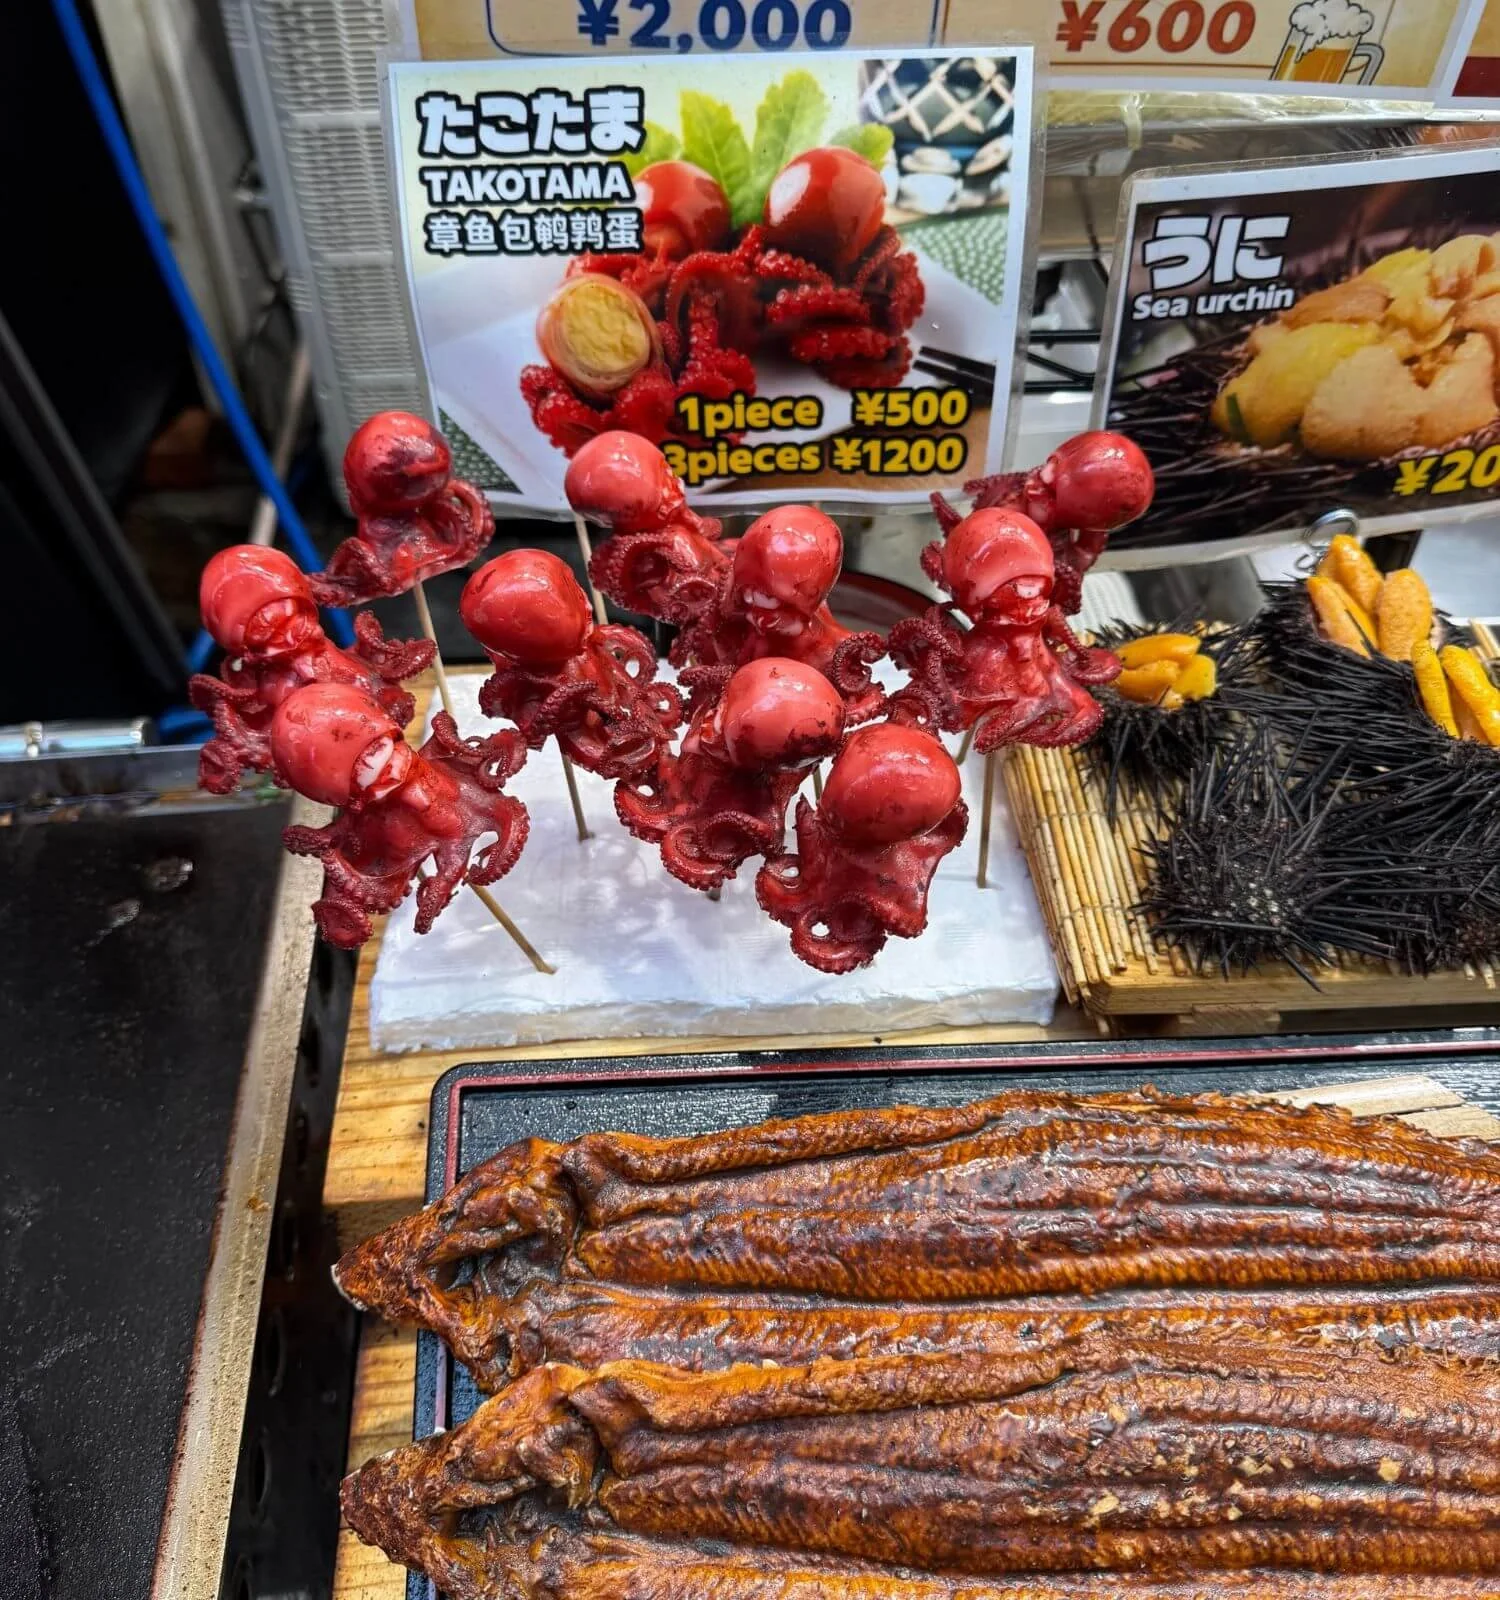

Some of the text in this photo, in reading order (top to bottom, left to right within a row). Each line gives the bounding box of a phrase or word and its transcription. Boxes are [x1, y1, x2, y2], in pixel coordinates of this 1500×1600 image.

[577, 0, 852, 53] ¥2,000
[1055, 0, 1256, 53] ¥600
[419, 88, 644, 155] たこたま
[422, 166, 632, 202] TAKOTAMA
[425, 212, 640, 252] 章鱼包鹌鹑蛋
[1143, 215, 1291, 290] うに
[1132, 284, 1294, 320] Sea urchin
[679, 390, 968, 437] 1piece ¥500
[665, 437, 965, 481] 3pieces ¥1200
